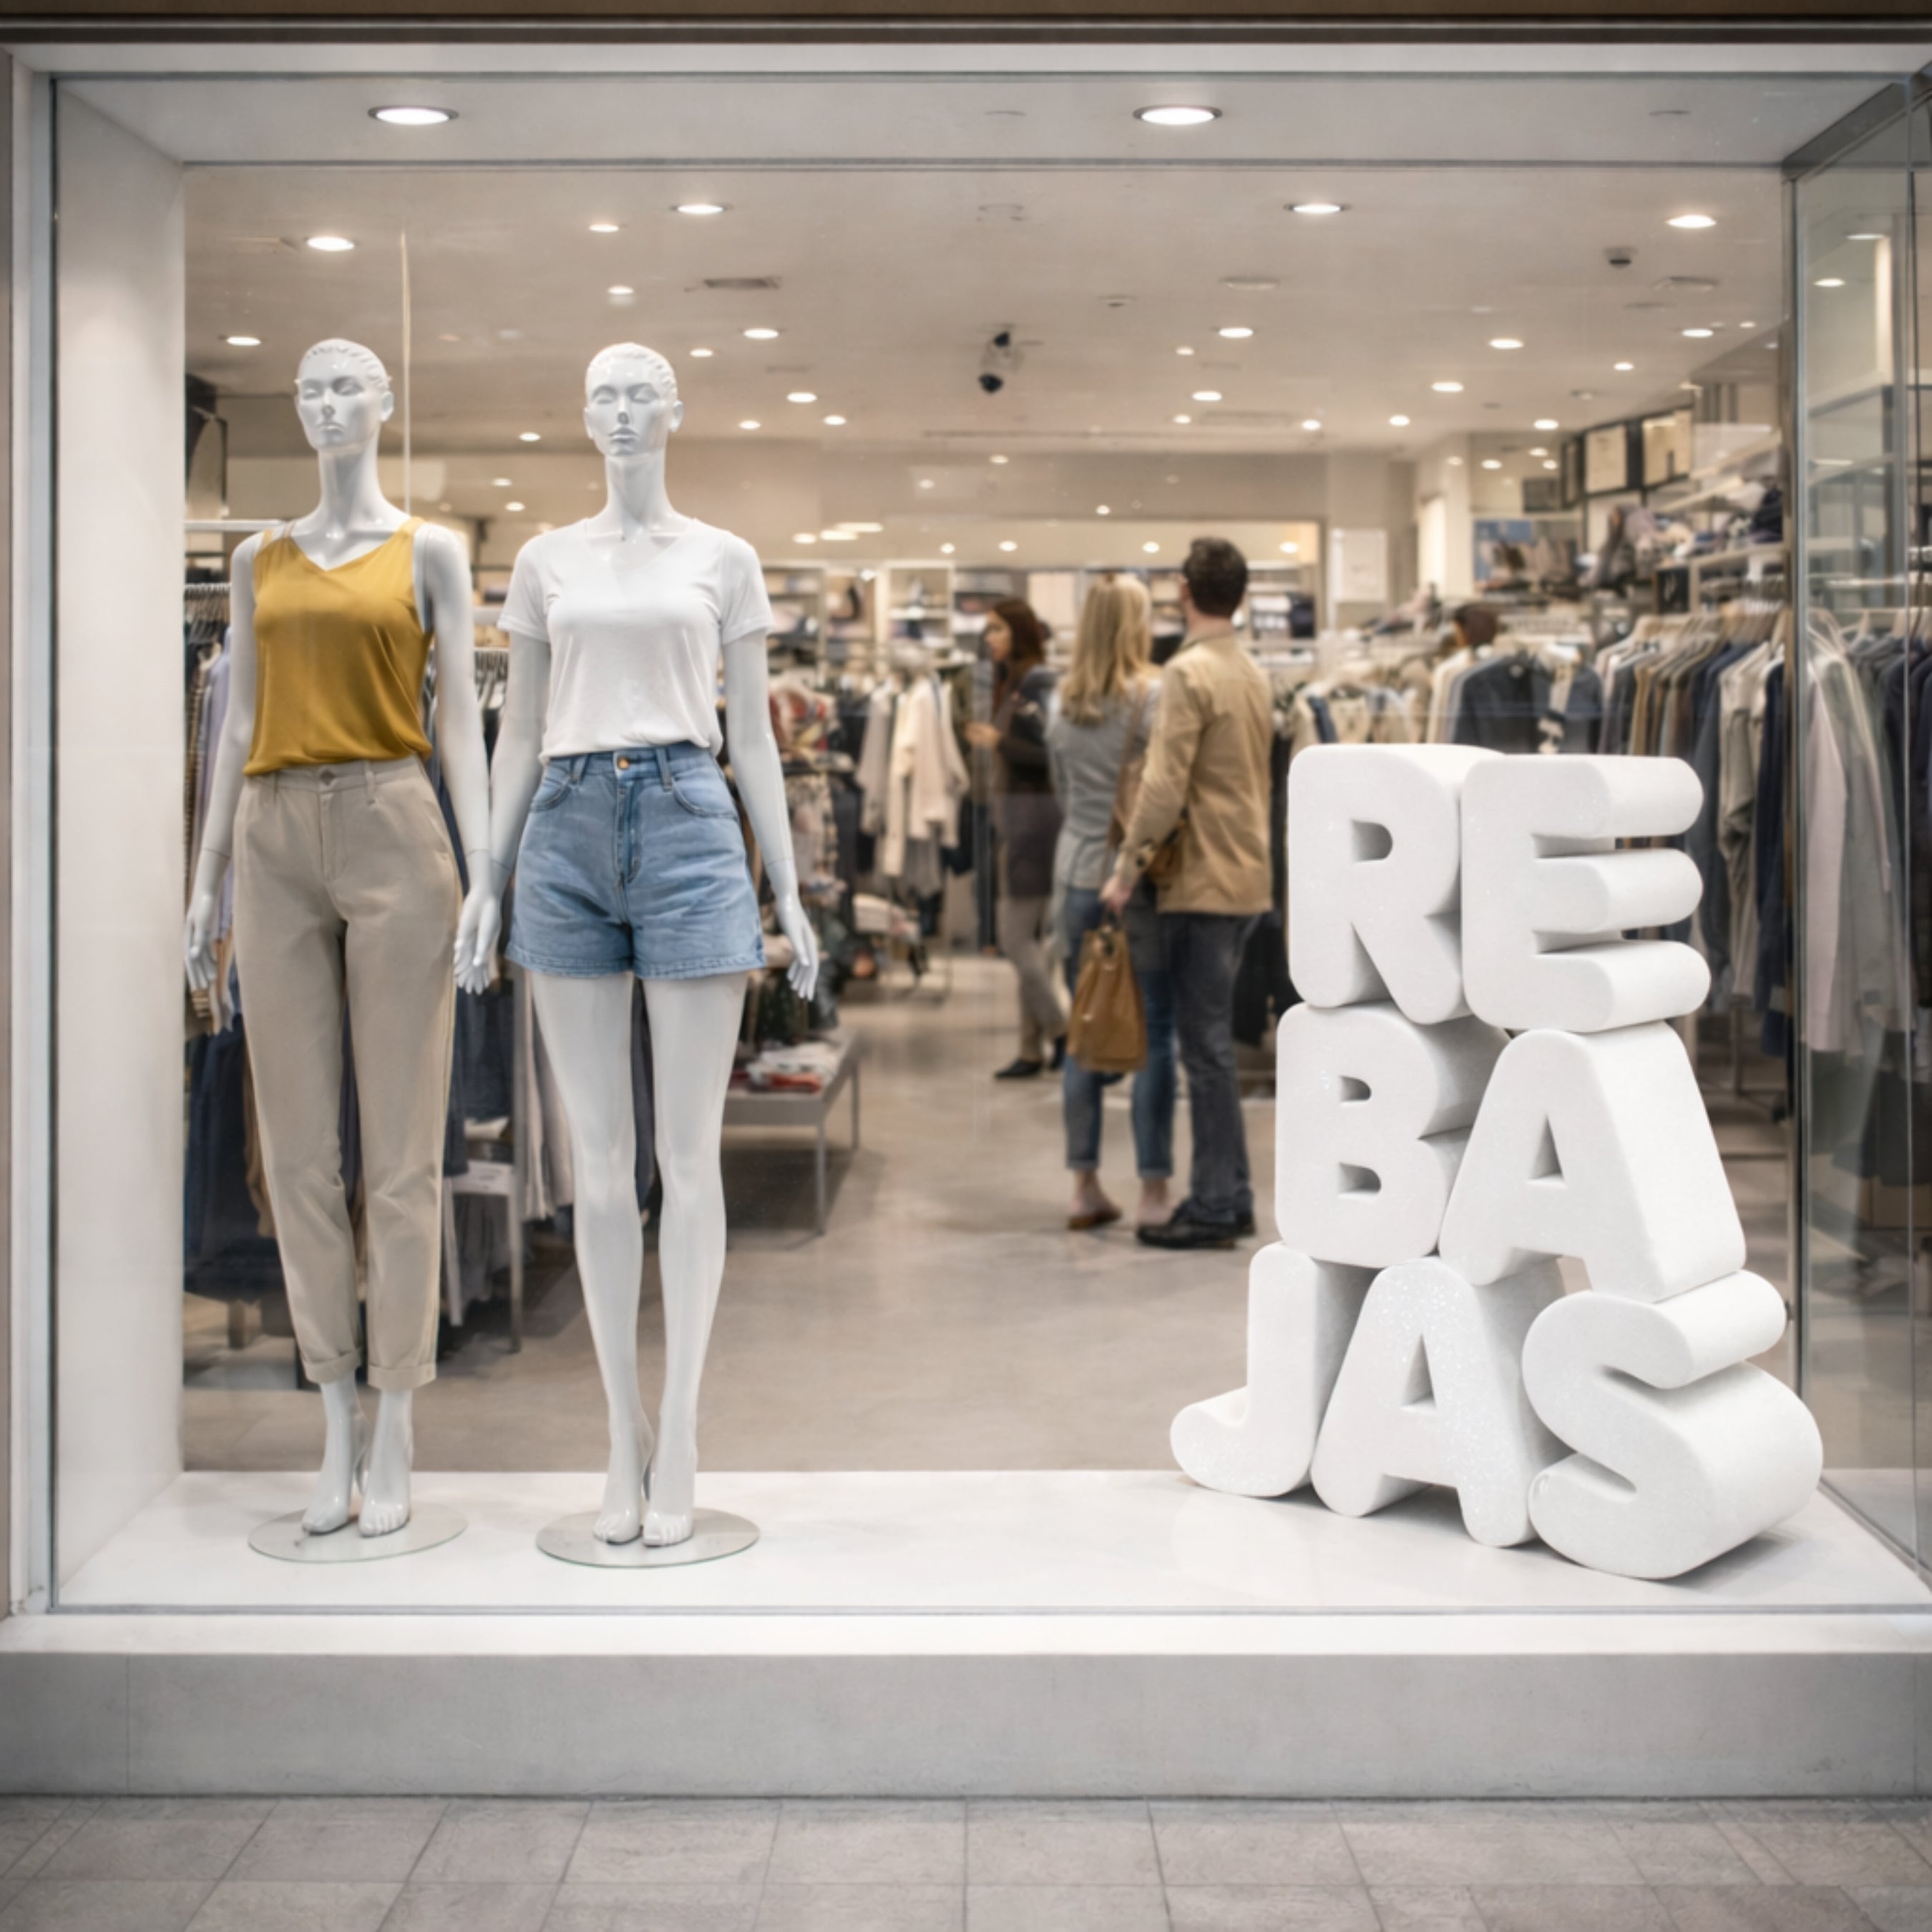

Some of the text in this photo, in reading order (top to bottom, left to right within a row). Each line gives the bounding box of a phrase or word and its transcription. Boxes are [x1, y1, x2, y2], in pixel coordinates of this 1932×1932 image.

[1289, 743, 1710, 1032] RE
[1276, 1003, 1746, 1302] BA
[1170, 1242, 1823, 1579] JAS
